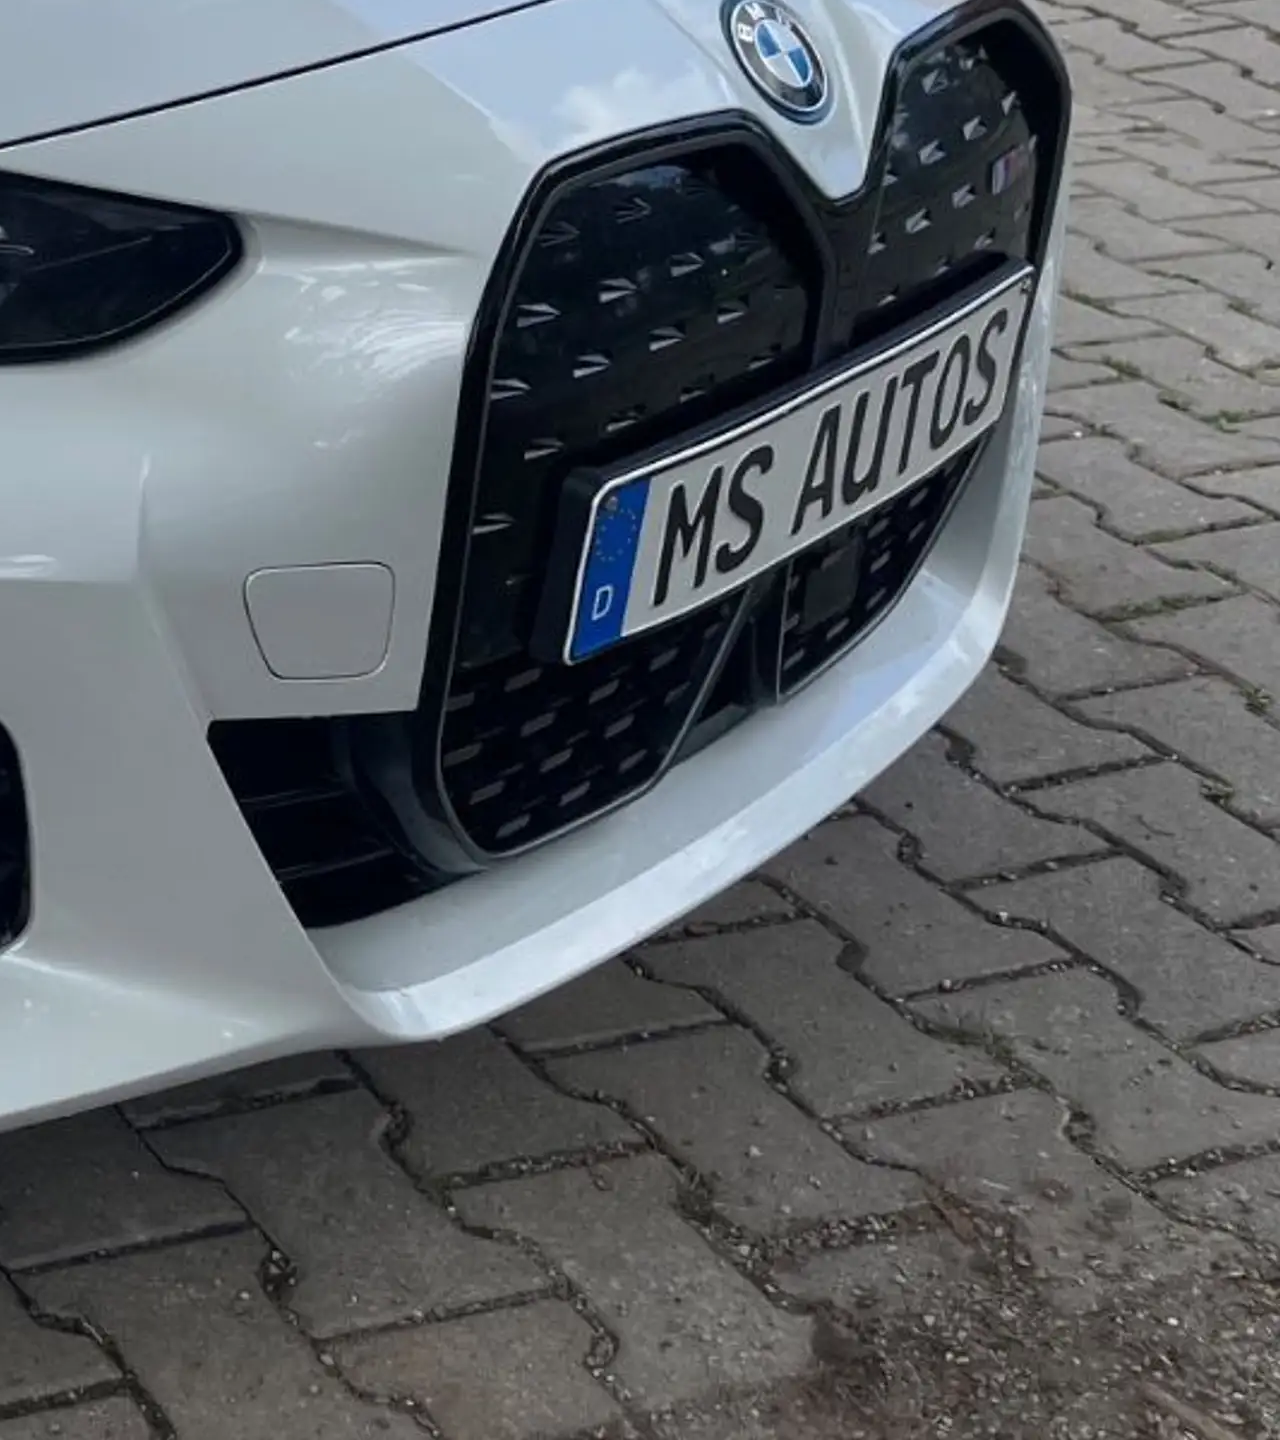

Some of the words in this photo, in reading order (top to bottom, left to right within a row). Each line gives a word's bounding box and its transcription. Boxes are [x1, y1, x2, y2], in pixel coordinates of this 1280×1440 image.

[591, 585, 613, 621] D
[653, 445, 774, 607] MS
[791, 308, 1008, 536] AUTOS
